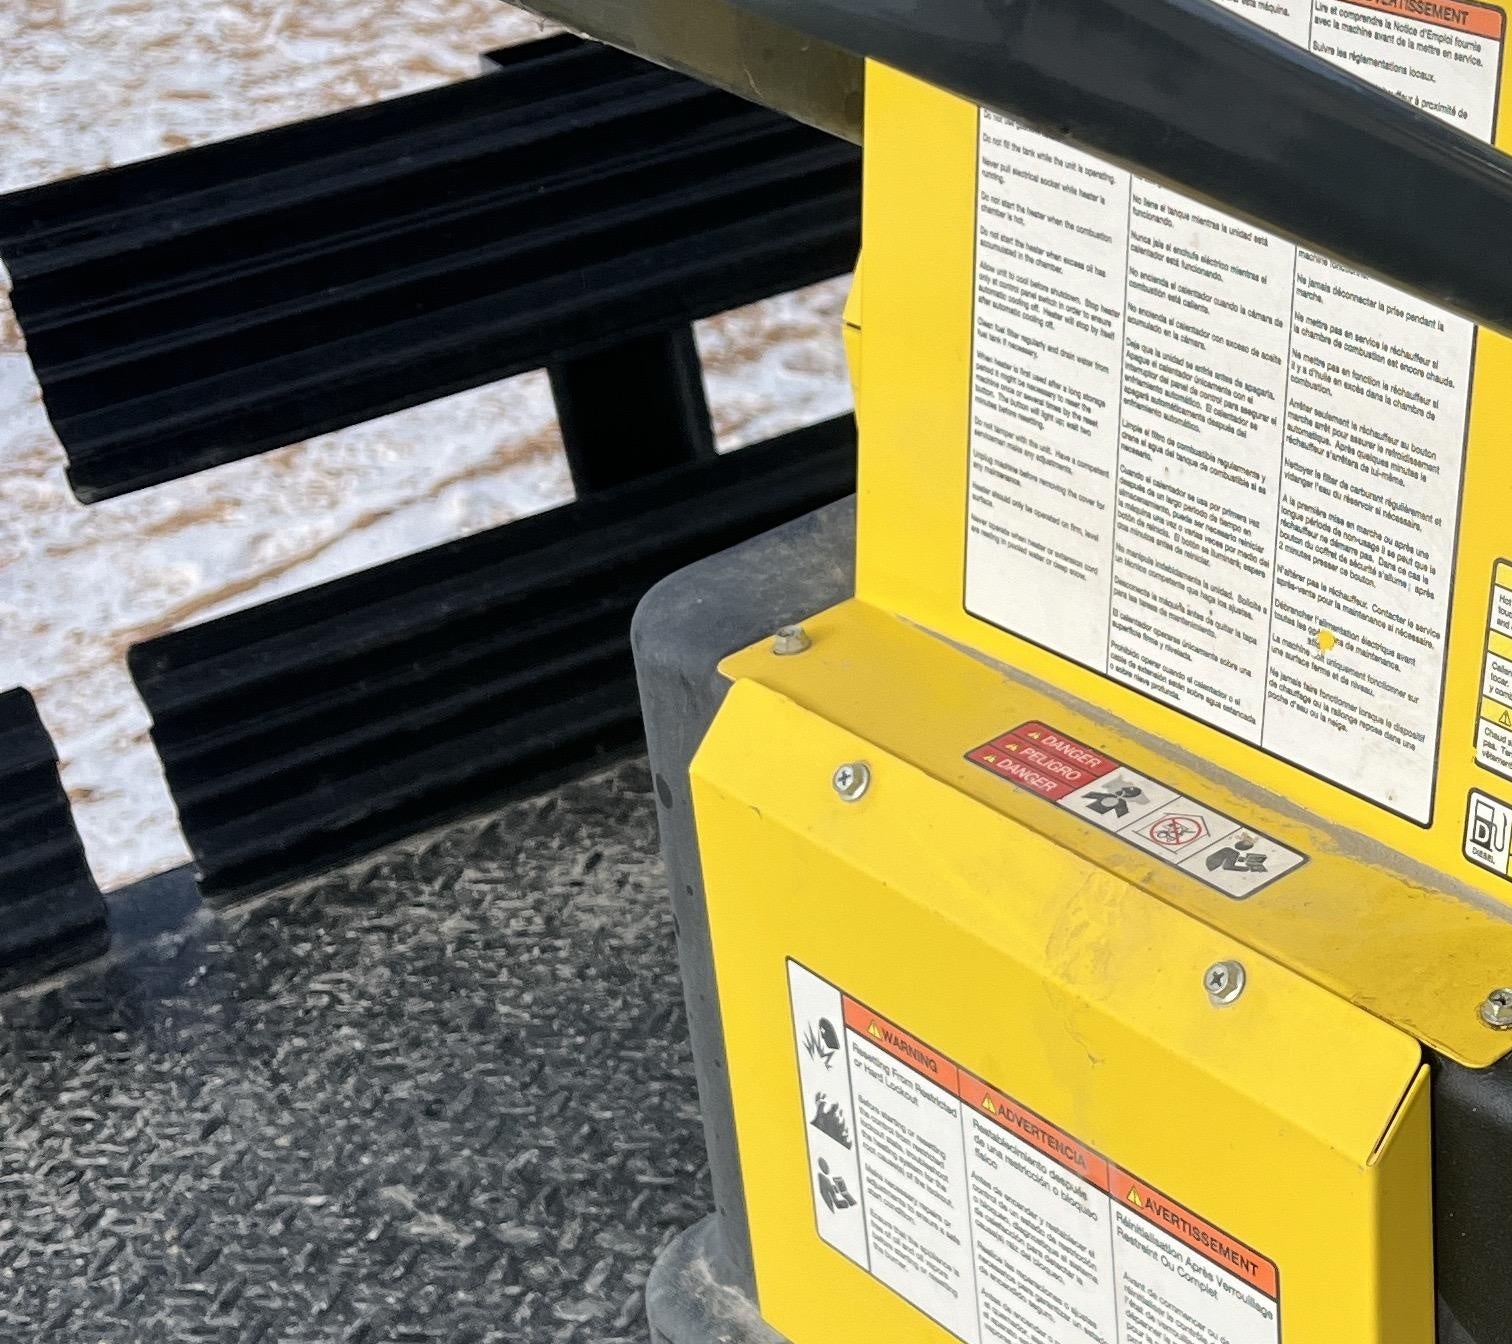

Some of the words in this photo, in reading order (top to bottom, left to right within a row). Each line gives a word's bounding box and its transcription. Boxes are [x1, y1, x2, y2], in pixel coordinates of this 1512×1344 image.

[1498, 594, 1511, 607] Hot
[994, 758, 1060, 791] DANGER
[1017, 746, 1084, 781] PELIGRO
[1039, 734, 1104, 768] DANGER
[1471, 846, 1495, 864] DIESEL
[880, 1027, 937, 1074] WARNING
[851, 1040, 889, 1075] Resetting
[891, 1067, 912, 1088] From
[915, 1082, 957, 1118] Restricted
[853, 1058, 861, 1069] or
[864, 1062, 883, 1083] Hard
[885, 1076, 918, 1106] Lockout
[996, 1100, 1086, 1168] ADVERTENCIA
[973, 1118, 1045, 1174] Restablecimiento
[1051, 1169, 1087, 1201] después
[1144, 1195, 1259, 1278] AVERTISSEMENT
[1117, 1225, 1157, 1260] Restreint
[1160, 1254, 1173, 1271] Ou
[1177, 1264, 1217, 1299] Complet
[1217, 1275, 1272, 1319] Verrouillage
